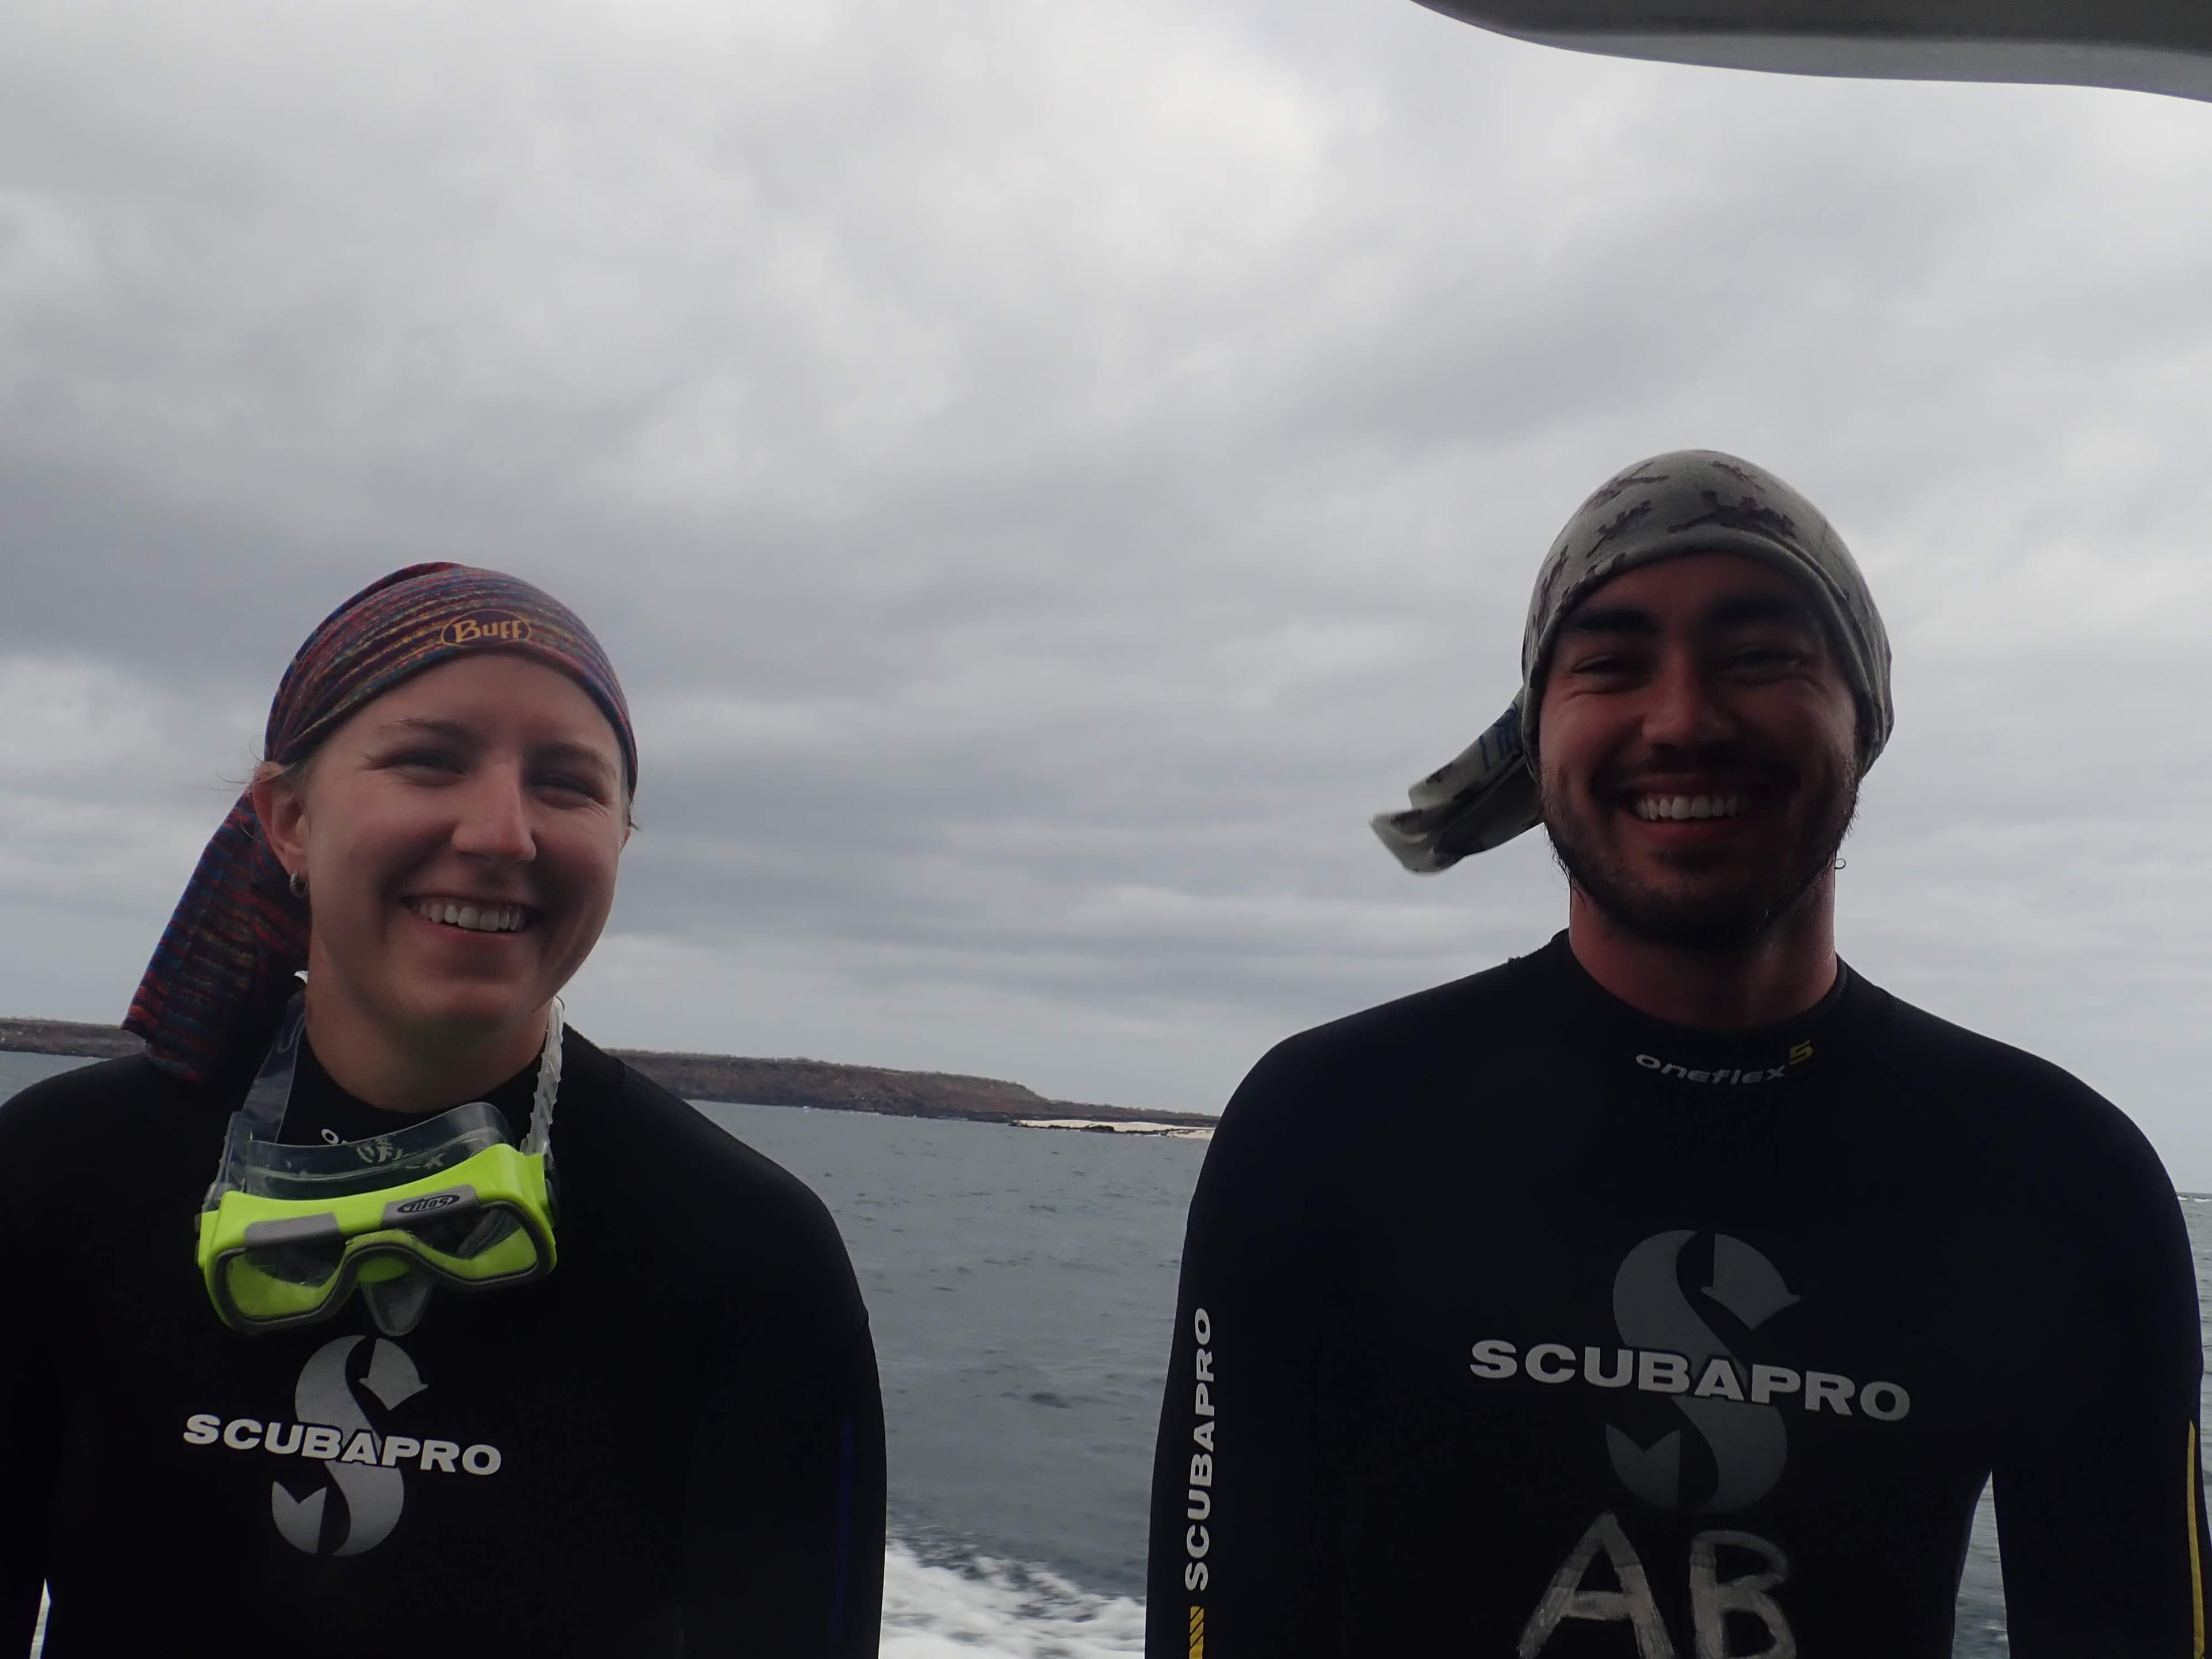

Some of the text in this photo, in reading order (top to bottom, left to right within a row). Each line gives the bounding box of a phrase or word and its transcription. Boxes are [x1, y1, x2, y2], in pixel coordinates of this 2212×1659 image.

[452, 619, 522, 643] Buff
[1469, 1339, 1911, 1422] SCUBAPRO
[183, 1413, 502, 1476] SCUBAPRO
[1185, 1308, 1215, 1591] SCUBAPRO
[1516, 1510, 1798, 1659] AB
